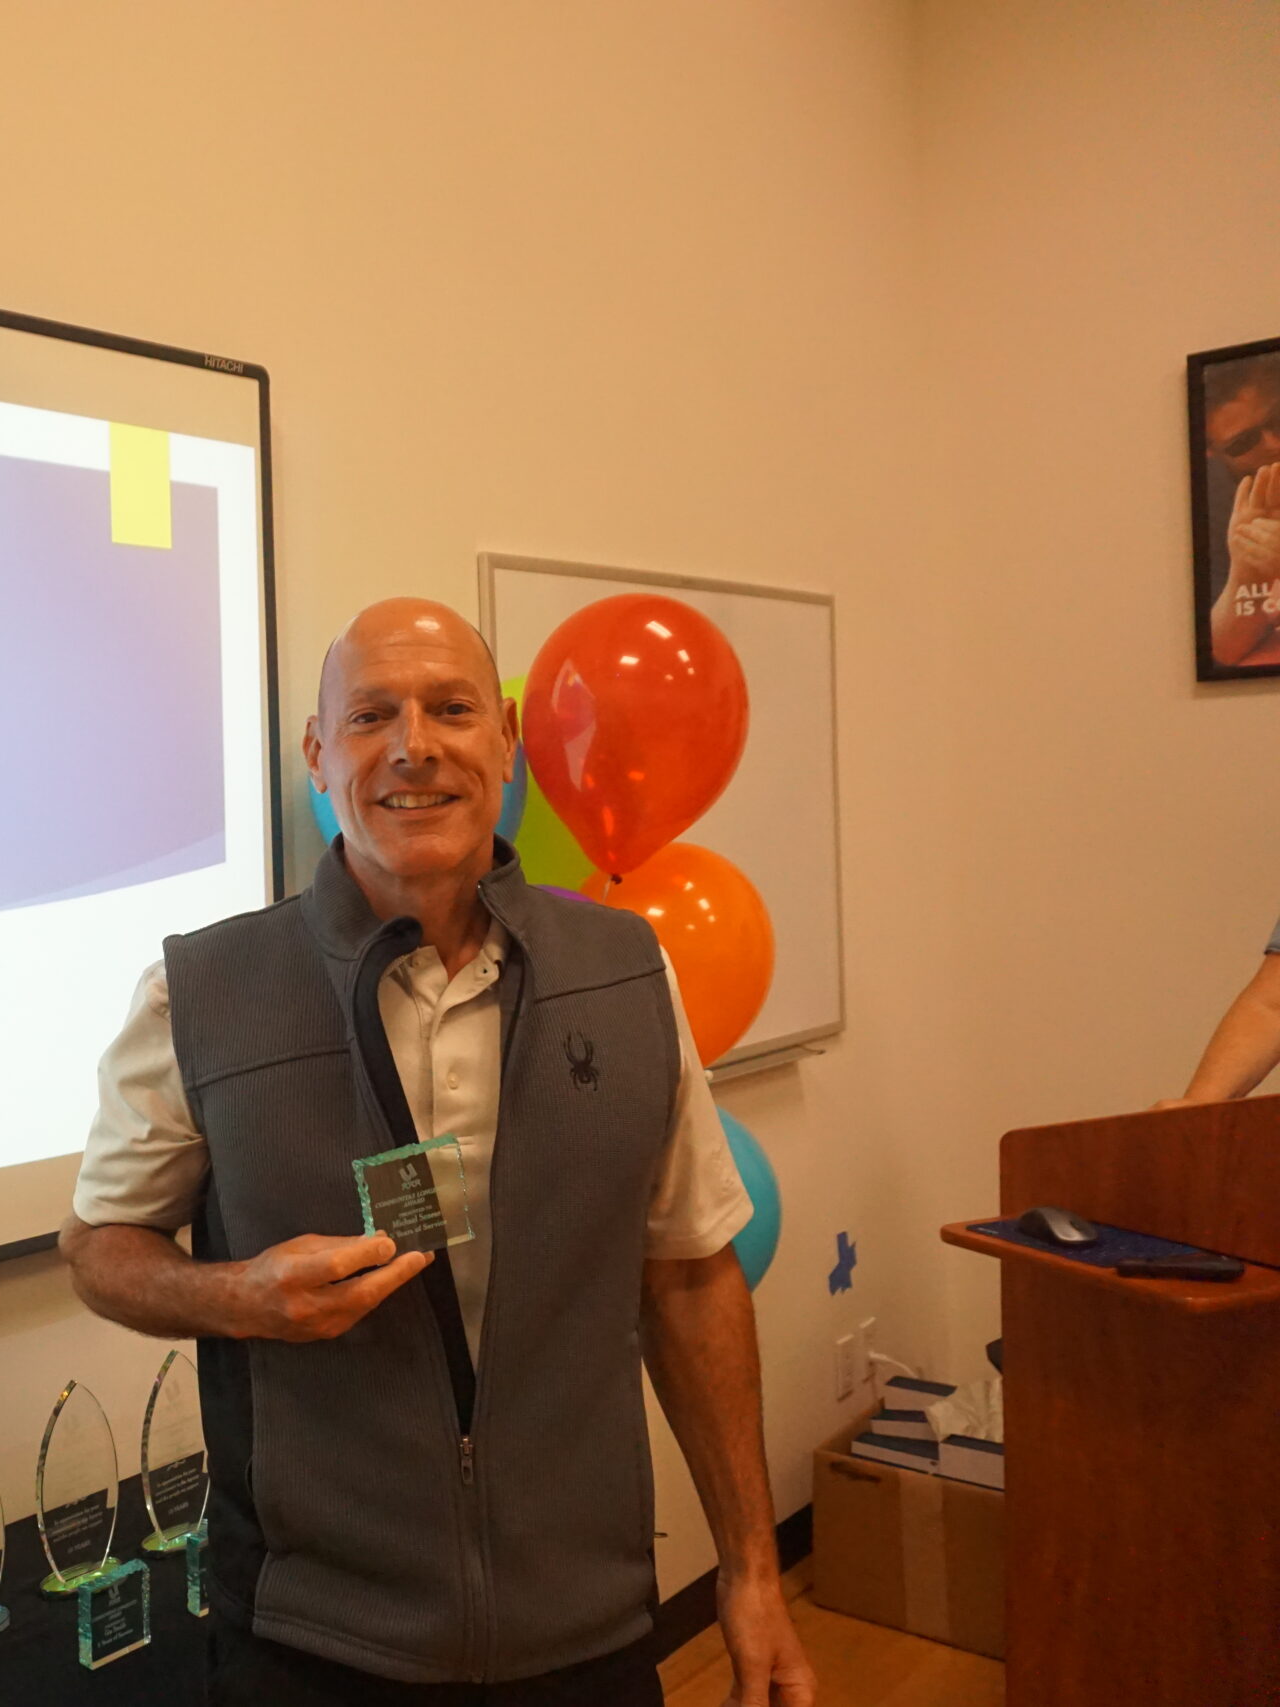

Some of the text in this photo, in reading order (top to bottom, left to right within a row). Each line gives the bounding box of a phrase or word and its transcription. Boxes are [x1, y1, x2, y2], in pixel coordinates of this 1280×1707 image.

[204, 355, 244, 374] HITACHI
[1235, 582, 1272, 599] ALL
[1235, 600, 1255, 616] IS
